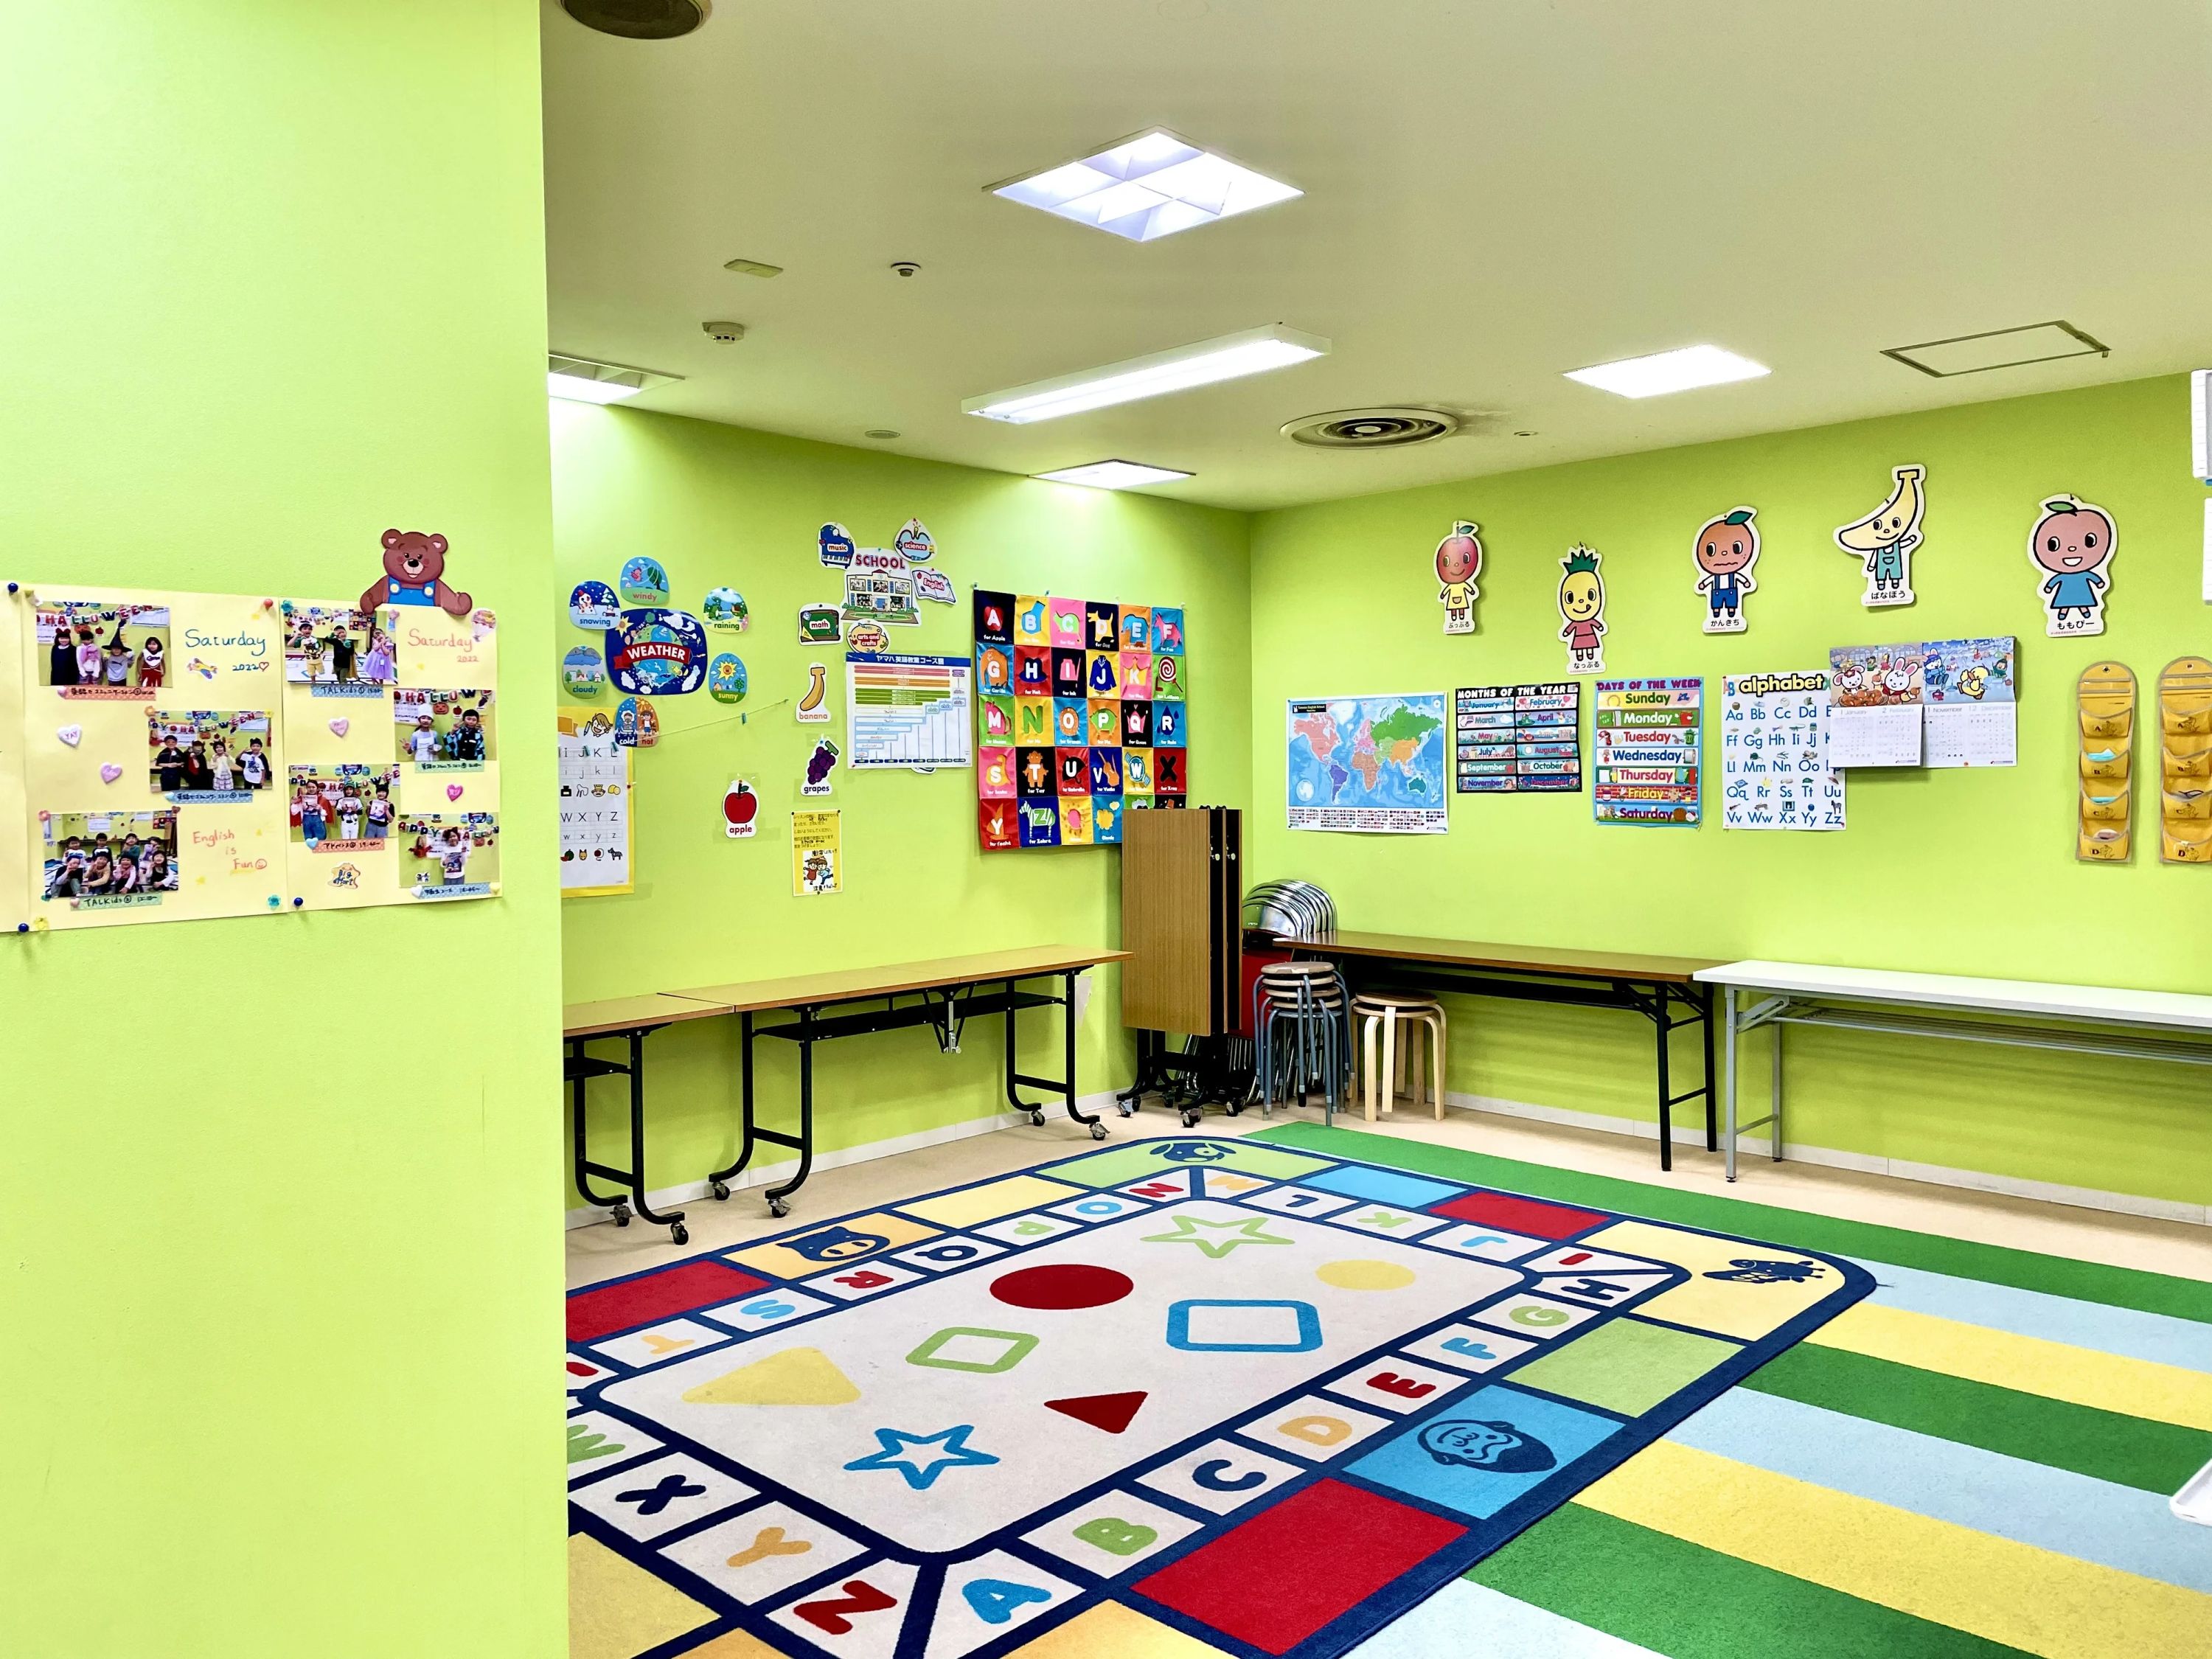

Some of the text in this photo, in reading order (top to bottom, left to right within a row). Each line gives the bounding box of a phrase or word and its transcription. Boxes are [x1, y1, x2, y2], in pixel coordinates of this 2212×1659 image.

[828, 543, 847, 552] music
[904, 542, 926, 550] science
[855, 554, 906, 569] SCHOOL
[923, 578, 945, 591] English
[633, 592, 657, 602] windy
[579, 617, 611, 627] snowing
[987, 608, 1001, 627] A
[1025, 613, 1037, 631] B
[1062, 616, 1074, 632] C
[714, 622, 740, 631] raining
[1096, 619, 1107, 635] D
[1132, 622, 1142, 638] E
[1163, 625, 1173, 639] F
[185, 629, 266, 656] Saturday
[408, 628, 473, 653] Saturday
[627, 644, 686, 661] WEATHER
[988, 661, 1001, 678] G
[1026, 661, 1038, 679] H
[1096, 668, 1106, 684] J
[1130, 669, 1140, 685] K
[572, 685, 598, 695] cloudy
[1457, 686, 1566, 699] MONTHS OF THE YEAR
[1596, 679, 1702, 691] DAYS OF THE WEEK
[1739, 674, 1823, 697] alphabet
[718, 692, 738, 701] sunny
[1530, 698, 1562, 706] February
[1625, 692, 1671, 706] Sunday
[1471, 701, 1500, 709] January
[988, 712, 1001, 728] M
[1023, 706, 1043, 734] N
[1062, 713, 1074, 728] O
[1098, 712, 1109, 728] P
[1537, 713, 1554, 723] April
[1624, 712, 1672, 726] Monday
[1725, 706, 1817, 720] Aa Bb Cc Dd
[1130, 715, 1141, 732] Q
[1162, 716, 1172, 731] R
[619, 737, 635, 745] cold
[1478, 732, 1493, 741] May
[1623, 731, 1672, 745] Tuesday
[1727, 733, 1816, 749] Ff Gg Hh Ii Jj
[594, 748, 602, 757] K
[1478, 746, 1559, 756] July August
[1613, 750, 1682, 764] Wednesday
[1029, 764, 1041, 780] T
[1065, 761, 1077, 777] U
[1131, 763, 1142, 779] W
[1160, 755, 1177, 783] X
[1467, 762, 1562, 773] September October
[1727, 759, 1820, 773] Ll Mm Nn Oo
[990, 765, 1001, 783] S
[1093, 768, 1102, 783] V
[1619, 769, 1673, 782] Thursday
[804, 785, 830, 793] grapes
[1628, 787, 1665, 800] Friday
[1726, 785, 1841, 801] Qq Rr Ss Tt Uu
[560, 812, 618, 822] W X Y Z
[1034, 809, 1047, 825] Z
[1619, 807, 1673, 822] Saturday
[1727, 812, 1842, 827] Vv Ww Xx Yy Zz
[729, 825, 753, 835] apple
[991, 818, 1003, 835] Y
[192, 829, 234, 847] English
[226, 846, 237, 855] is
[2178, 849, 2185, 858] D
[233, 858, 254, 869] Fun
[338, 869, 352, 878] Big
[333, 877, 353, 886] effort
[1129, 1183, 1184, 1197] N
[1076, 1201, 1122, 1214] O
[1013, 1221, 1055, 1236] P
[914, 1245, 979, 1262] Q
[833, 1270, 894, 1289] R
[1561, 1279, 1630, 1300] H
[740, 1299, 796, 1319] S
[1509, 1305, 1570, 1326] G
[641, 1335, 695, 1354] T
[1440, 1337, 1497, 1360] F
[1366, 1372, 1437, 1399] E
[1276, 1415, 1353, 1447] D
[1192, 1458, 1267, 1492] C
[615, 1474, 706, 1515] X
[1072, 1517, 1158, 1556] B
[726, 1527, 812, 1568] Y
[793, 1579, 897, 1635] Z
[961, 1579, 1052, 1624] A
